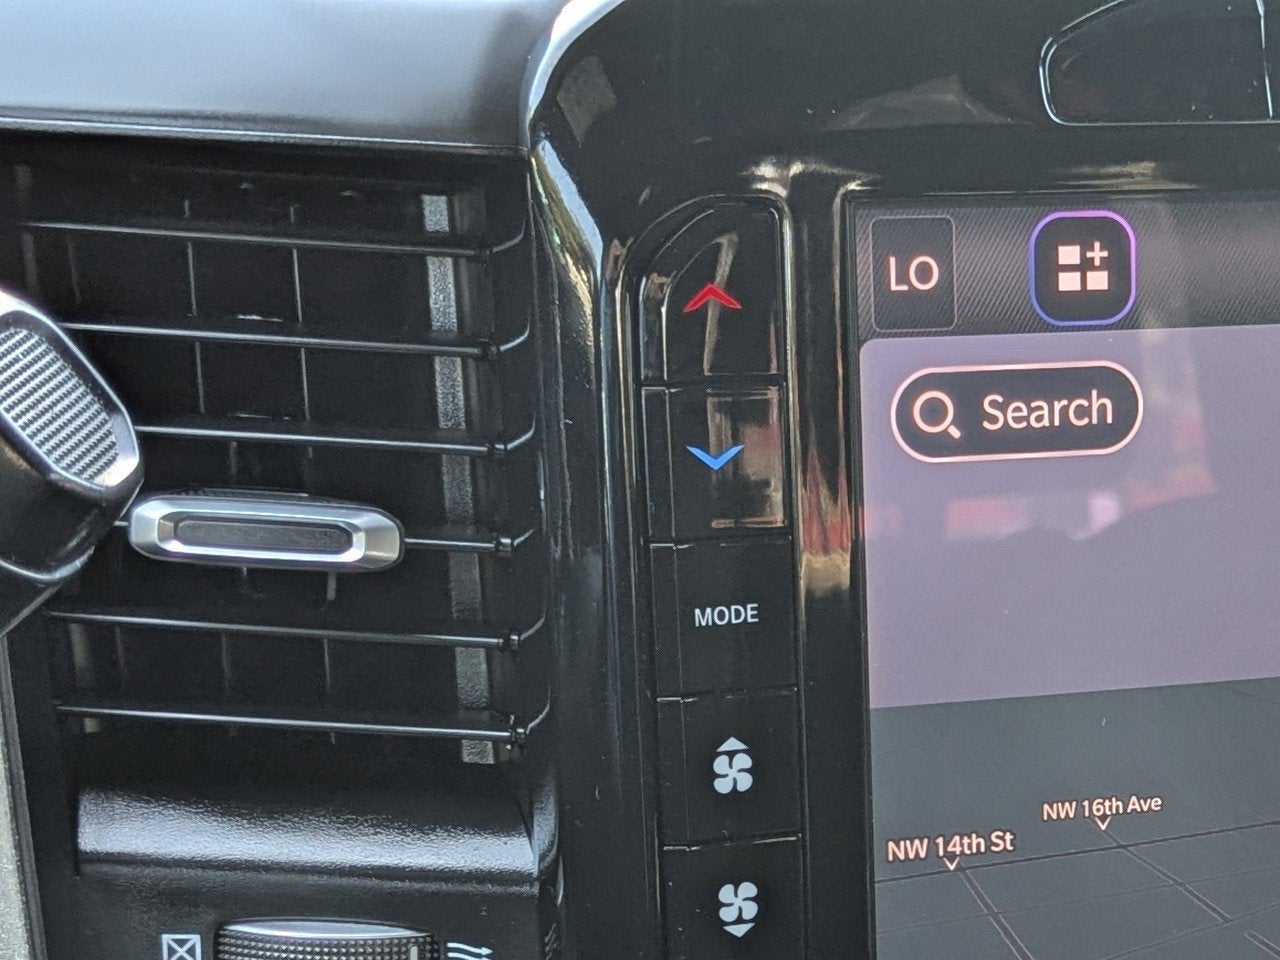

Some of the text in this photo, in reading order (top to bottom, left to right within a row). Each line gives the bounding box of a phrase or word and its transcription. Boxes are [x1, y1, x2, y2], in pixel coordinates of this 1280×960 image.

[888, 256, 939, 292] LO
[982, 389, 1114, 431] Search
[694, 603, 759, 627] MODE
[1042, 794, 1163, 822] NW 16th Ave
[887, 830, 1015, 862] NW 14th St
